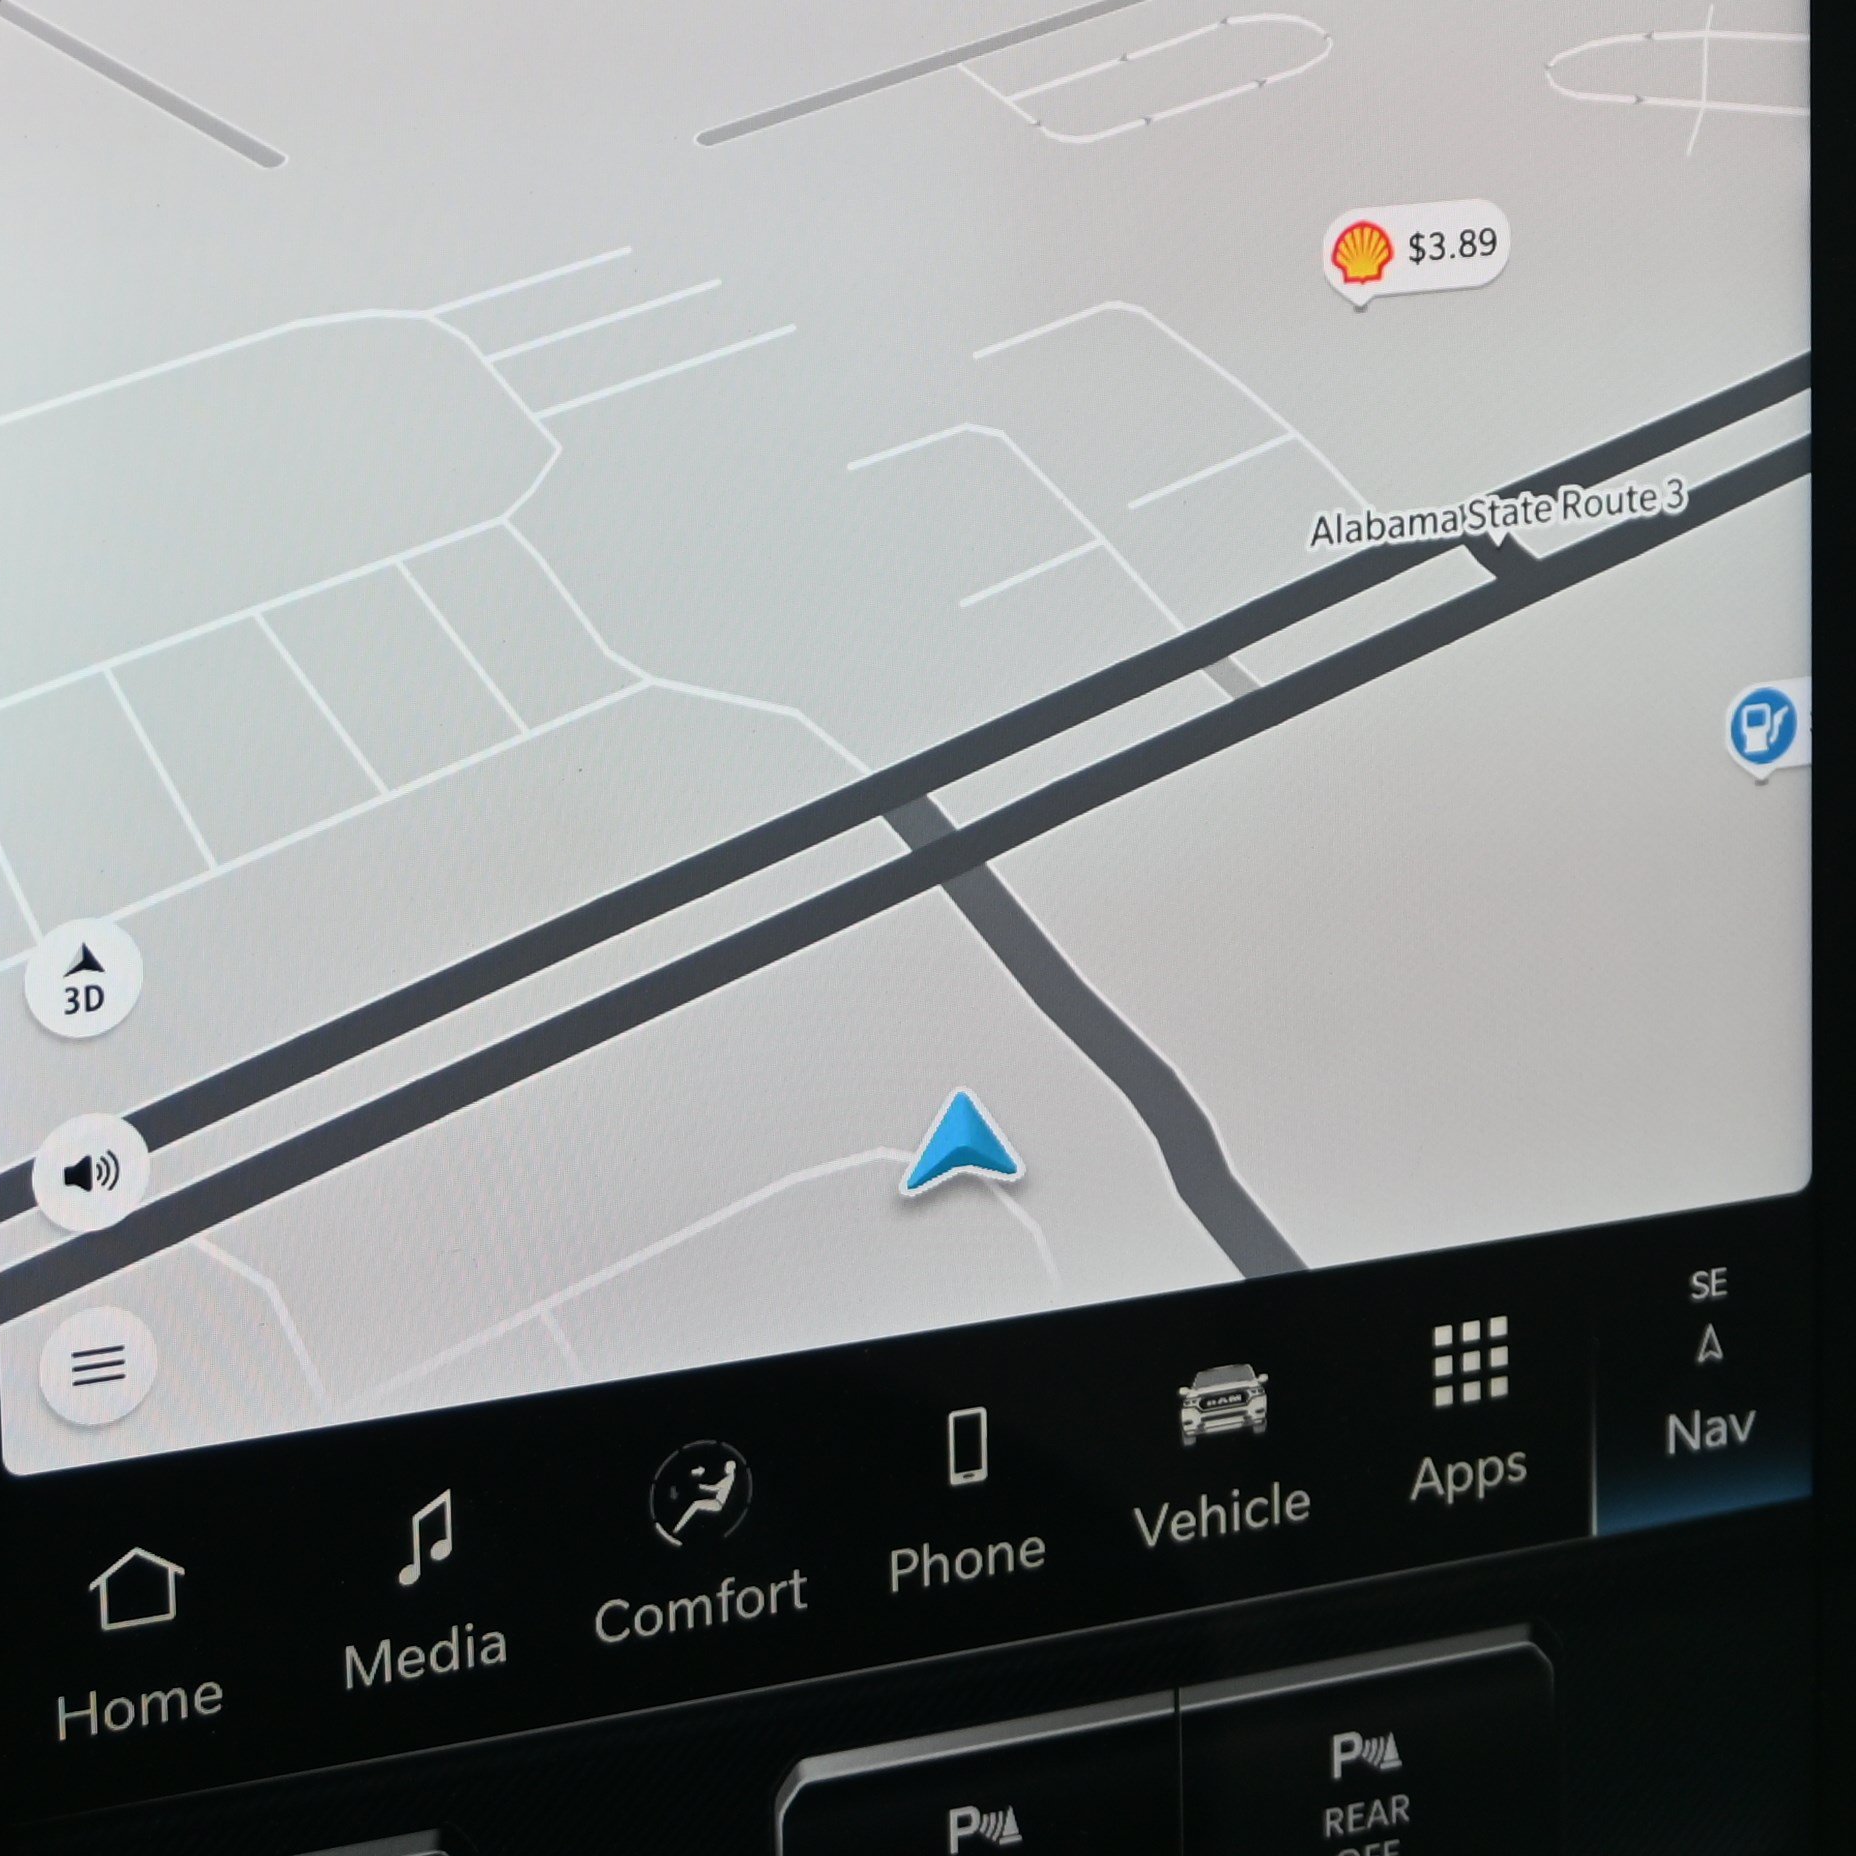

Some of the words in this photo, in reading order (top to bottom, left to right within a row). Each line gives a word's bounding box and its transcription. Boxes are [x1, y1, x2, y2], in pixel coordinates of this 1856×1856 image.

[1408, 227, 1498, 265] $3.89
[1310, 507, 1460, 548] Alabama
[1469, 497, 1554, 532] State
[1562, 488, 1658, 523] Route
[1666, 478, 1685, 510] 3
[63, 982, 105, 1016] 3D
[1690, 1267, 1727, 1301] SE
[1666, 1407, 1756, 1457] Nav
[1411, 1449, 1528, 1505] Apps
[1133, 1482, 1311, 1548] Vehicle
[888, 1528, 1046, 1593] Phone
[594, 1567, 809, 1645] Comfort
[345, 1622, 507, 1690] Media
[58, 1678, 224, 1741] Home
[1325, 1794, 1410, 1838] REAR
